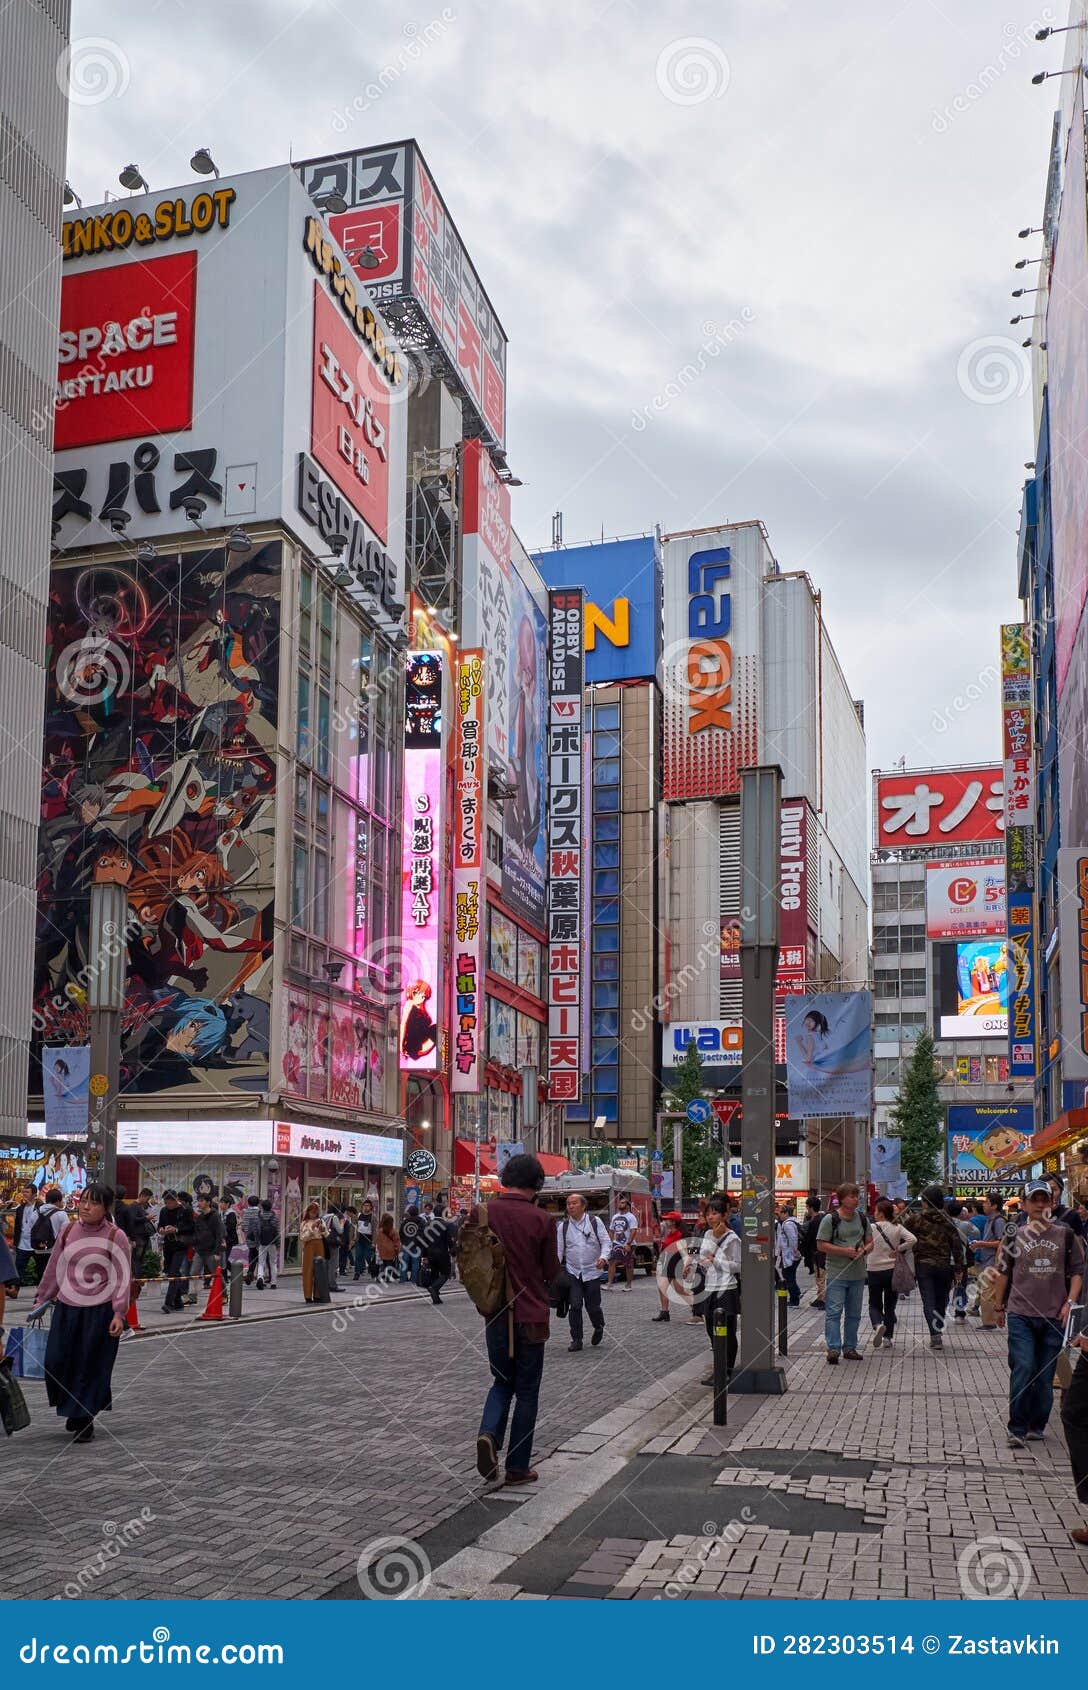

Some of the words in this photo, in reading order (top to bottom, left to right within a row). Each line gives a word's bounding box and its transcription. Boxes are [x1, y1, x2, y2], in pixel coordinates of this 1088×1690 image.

[308, 152, 402, 207] クス
[59, 312, 178, 364] SPACE
[320, 342, 387, 463] エスパス
[53, 442, 222, 520] スパス
[298, 452, 398, 602] ESPACE
[552, 595, 566, 691] PARADISE
[566, 595, 580, 658] HOBBY
[459, 664, 470, 714] 買います
[472, 659, 481, 696] DVD
[462, 721, 478, 772] 買取り
[1010, 711, 1026, 753] ウェルカム
[1013, 759, 1030, 809] 耳かき
[462, 798, 478, 860] まっくす
[780, 806, 803, 857] Duty
[467, 881, 479, 940] フィギュア
[780, 861, 804, 911] Free
[456, 893, 468, 942] 買います
[1011, 907, 1029, 924] 薬
[1011, 932, 1031, 1038] マツモトキヨシ
[976, 1107, 1007, 1115] Welcome
